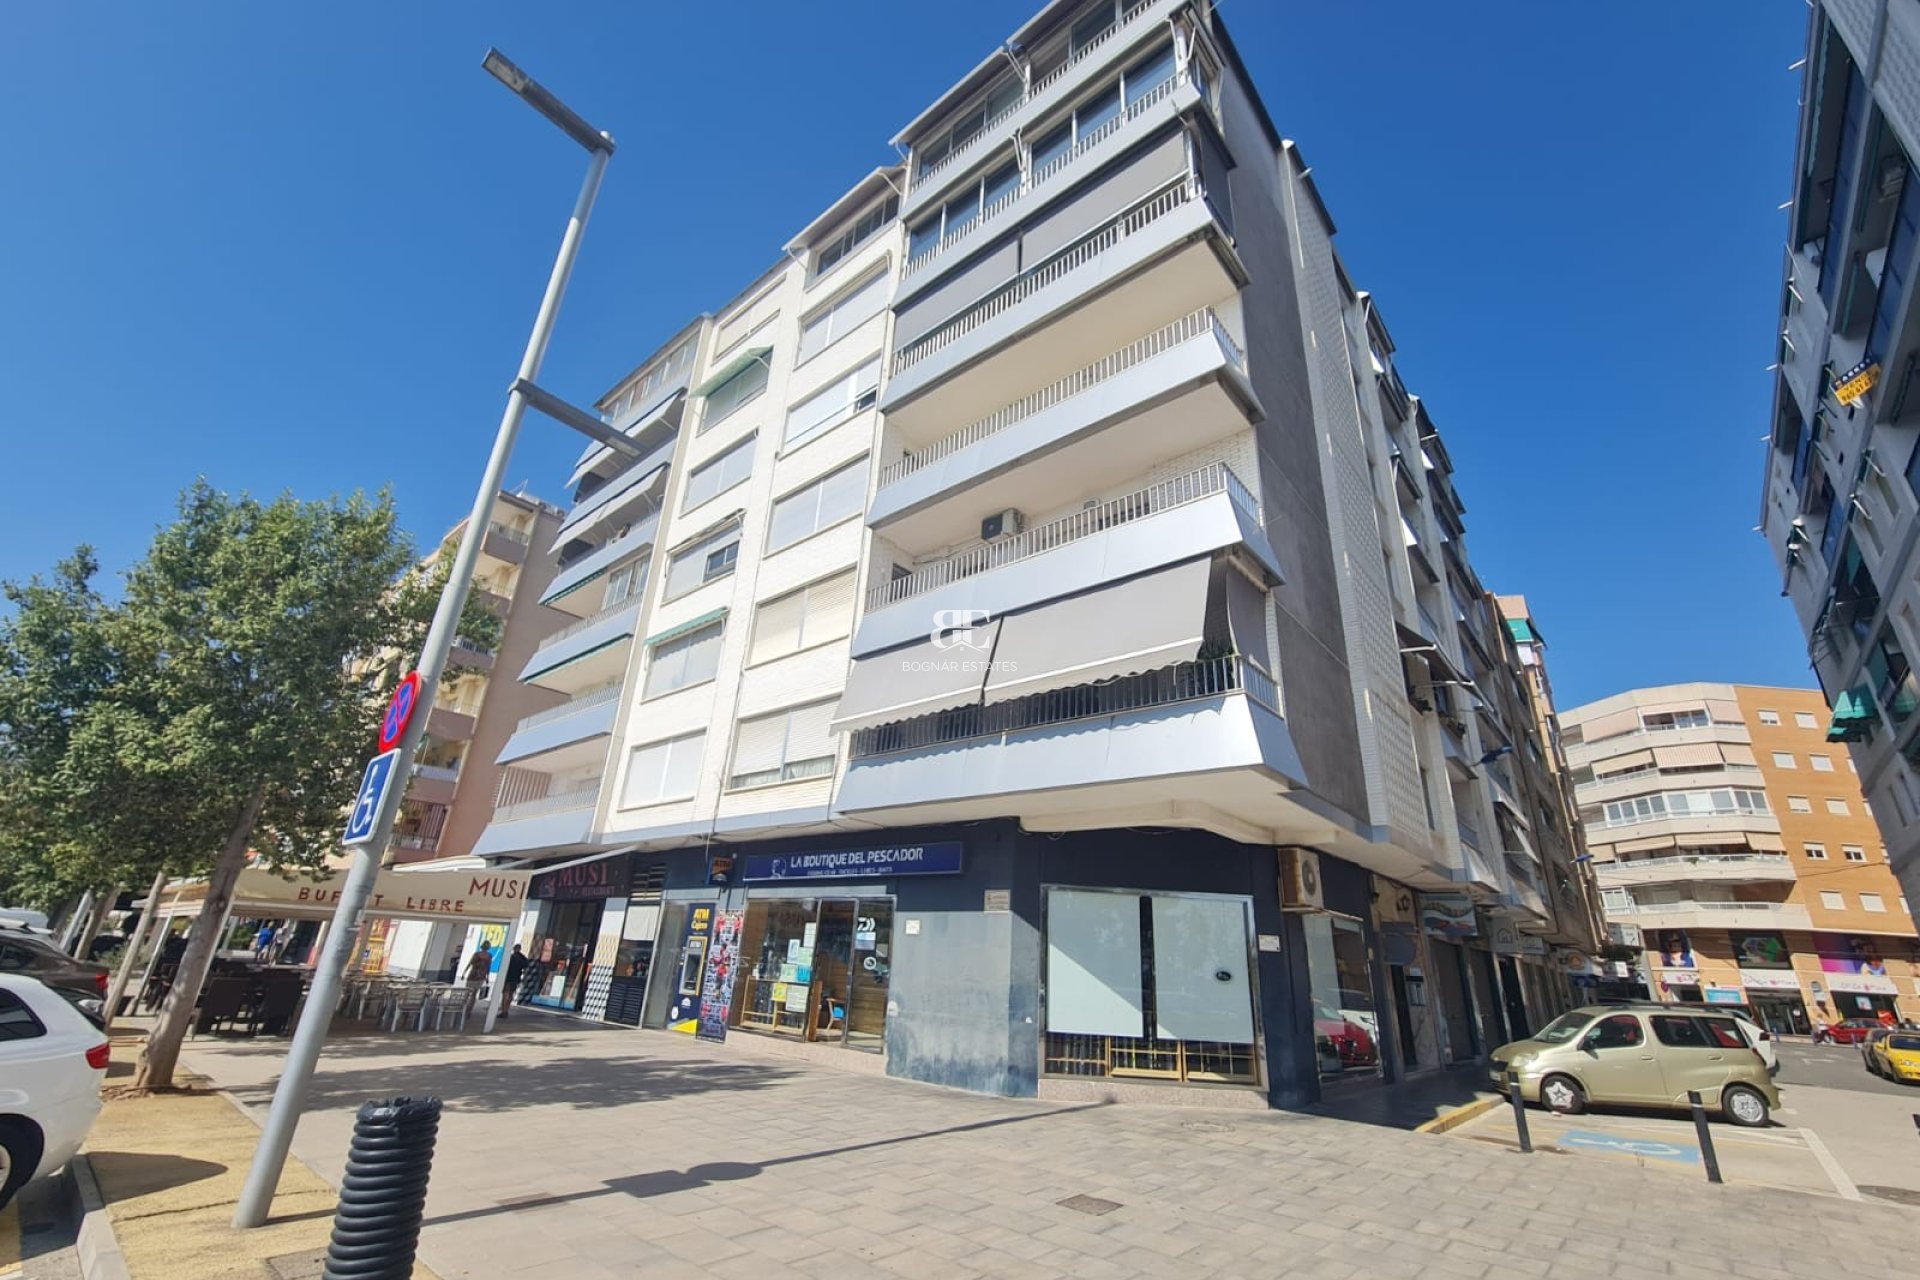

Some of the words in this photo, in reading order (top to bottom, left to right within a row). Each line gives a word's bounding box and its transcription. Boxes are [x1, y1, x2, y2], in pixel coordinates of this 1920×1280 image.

[790, 855, 801, 868] LA
[803, 853, 847, 868] BOUTIQUE
[848, 852, 865, 864] DEL
[867, 848, 923, 863] PESCADOR
[558, 863, 608, 887] MUSI
[298, 887, 384, 906] BUFT
[406, 896, 465, 912] LIBRE
[468, 877, 526, 900] MUSI
[693, 908, 710, 920] ATM
